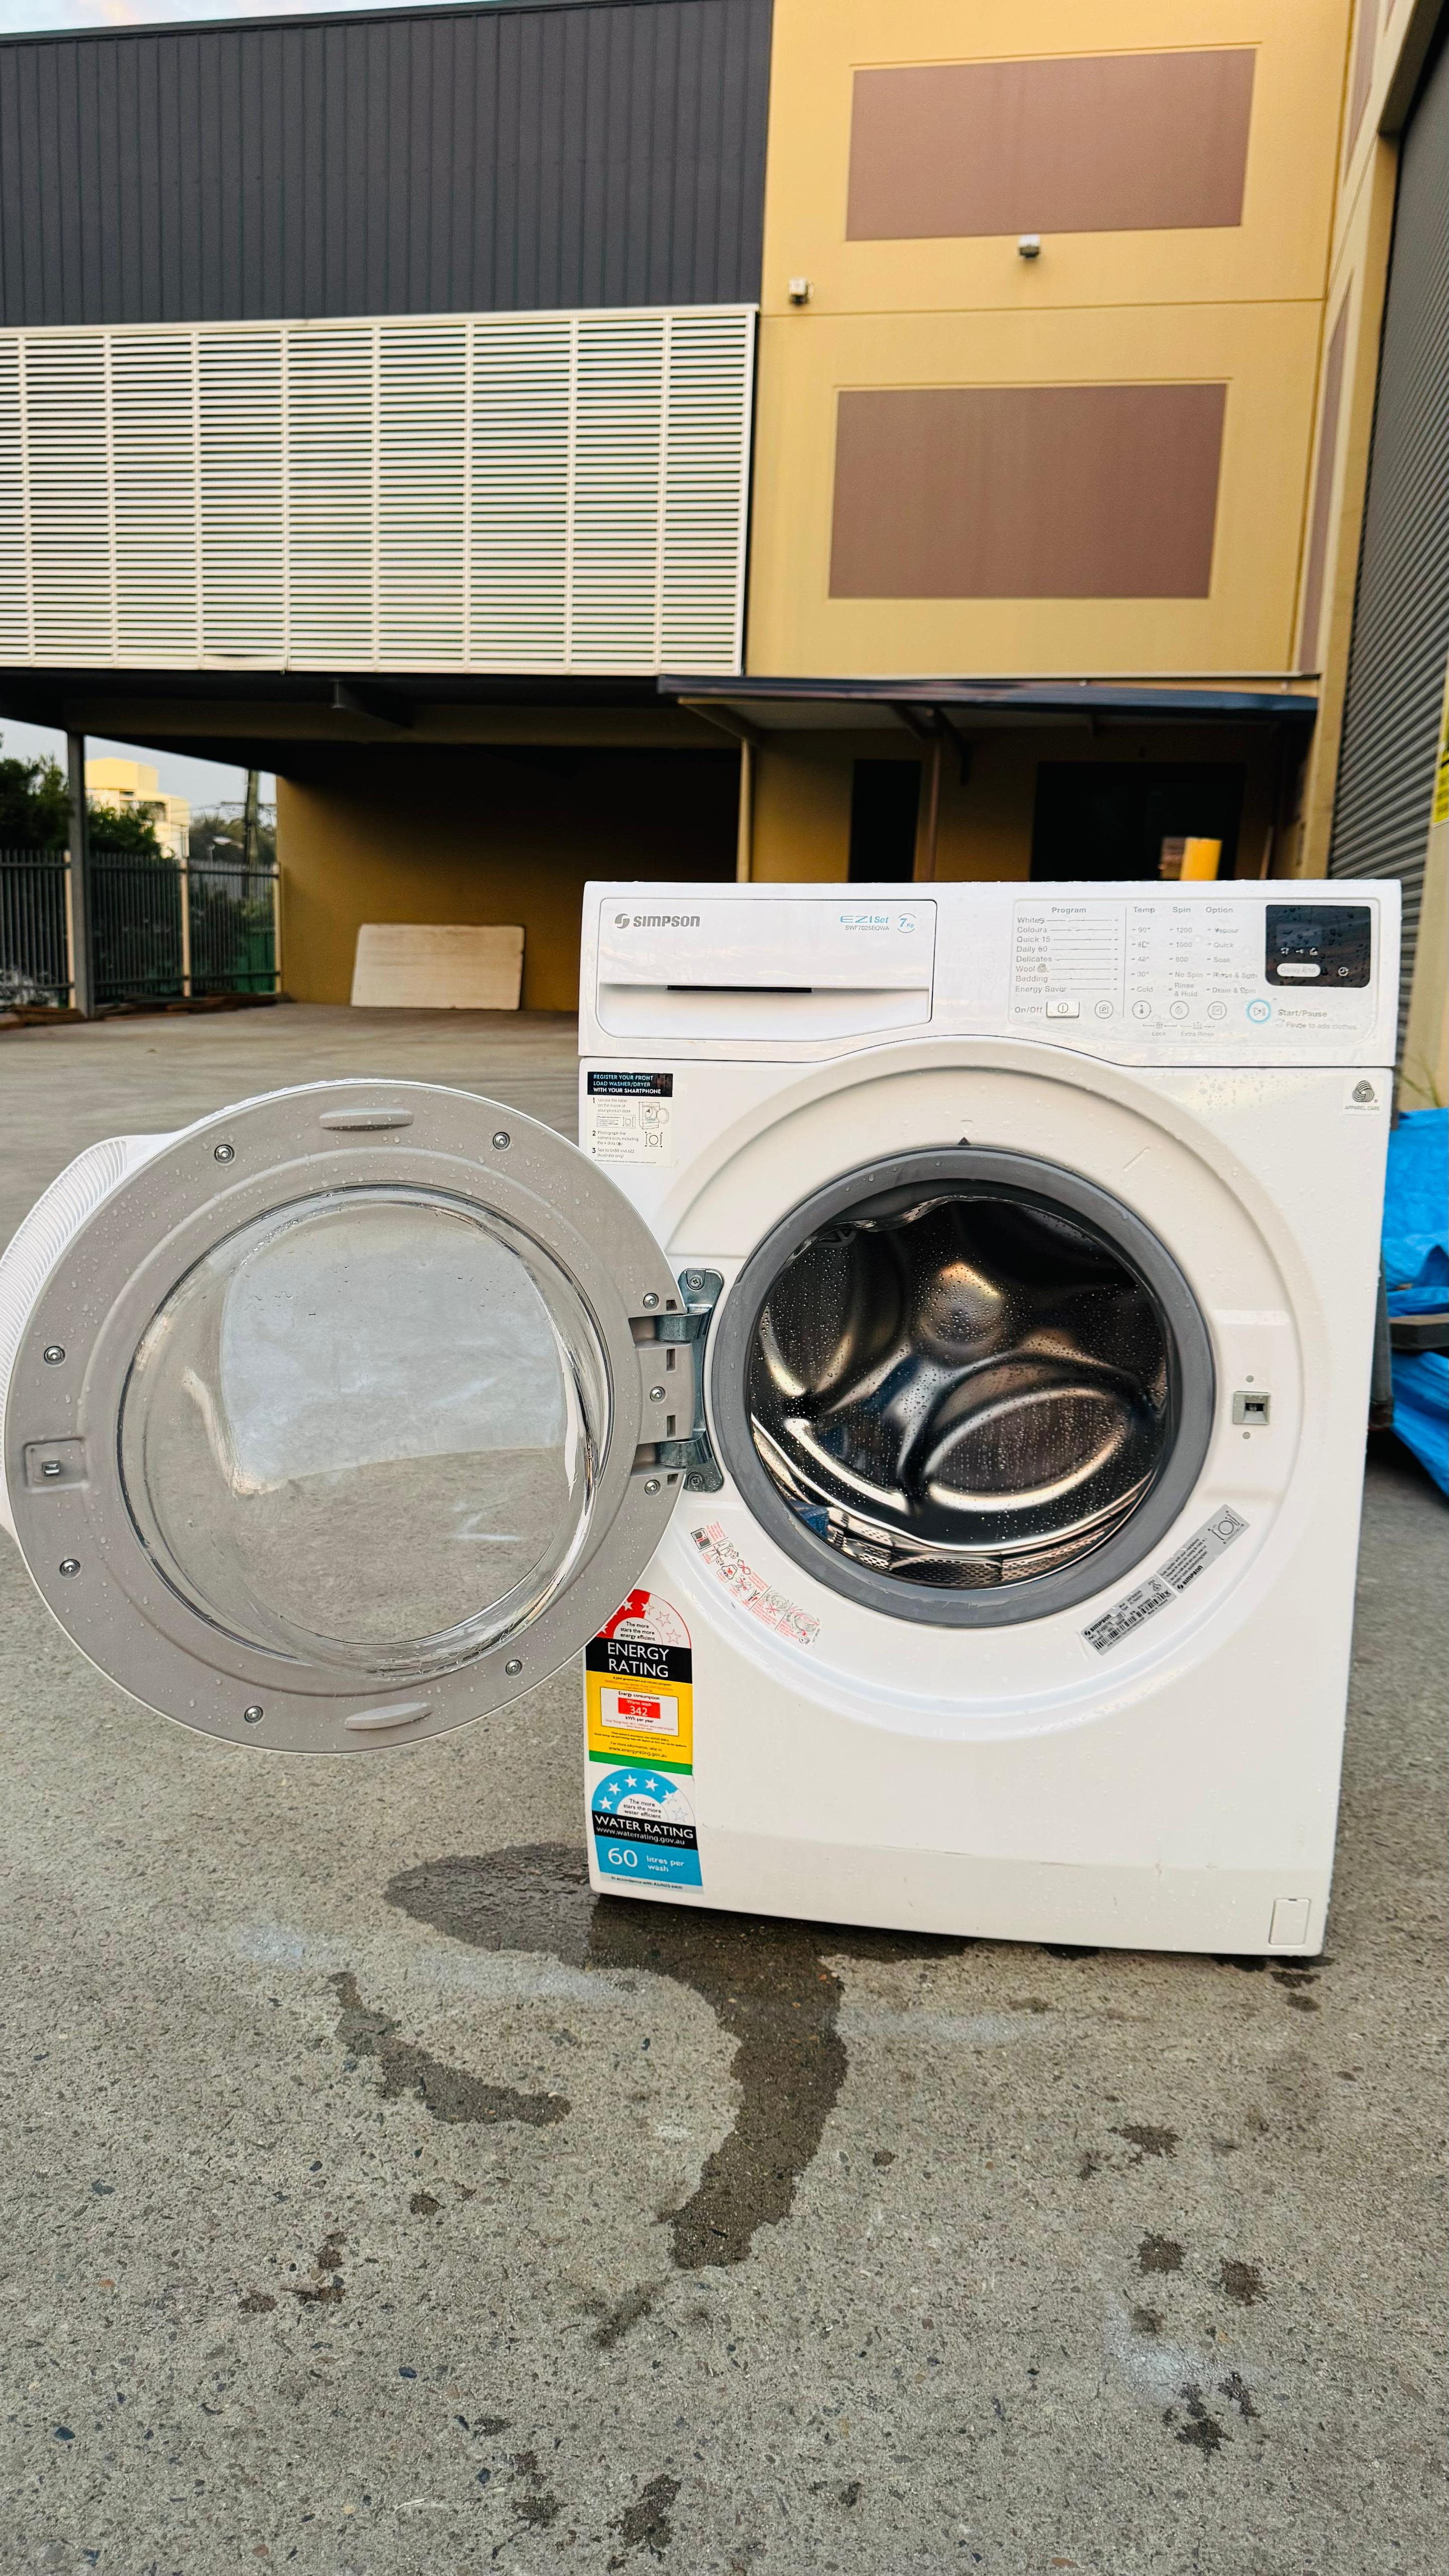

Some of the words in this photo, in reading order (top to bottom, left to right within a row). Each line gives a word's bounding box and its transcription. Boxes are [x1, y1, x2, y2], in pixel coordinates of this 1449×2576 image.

[633, 916, 700, 927] SIMPSON
[899, 918, 908, 927] 7
[1278, 1009, 1327, 1017] Start/Pause
[608, 1642, 669, 1661] ENERGY
[609, 1658, 669, 1677] RATING
[630, 1706, 648, 1717] 342
[595, 1814, 641, 1832] WATER
[644, 1822, 694, 1839] RATING
[596, 1826, 685, 1845] www.waterrating.gov.au
[608, 1847, 638, 1868] 60
[646, 1855, 668, 1865] litres
[648, 1864, 669, 1872] wash
